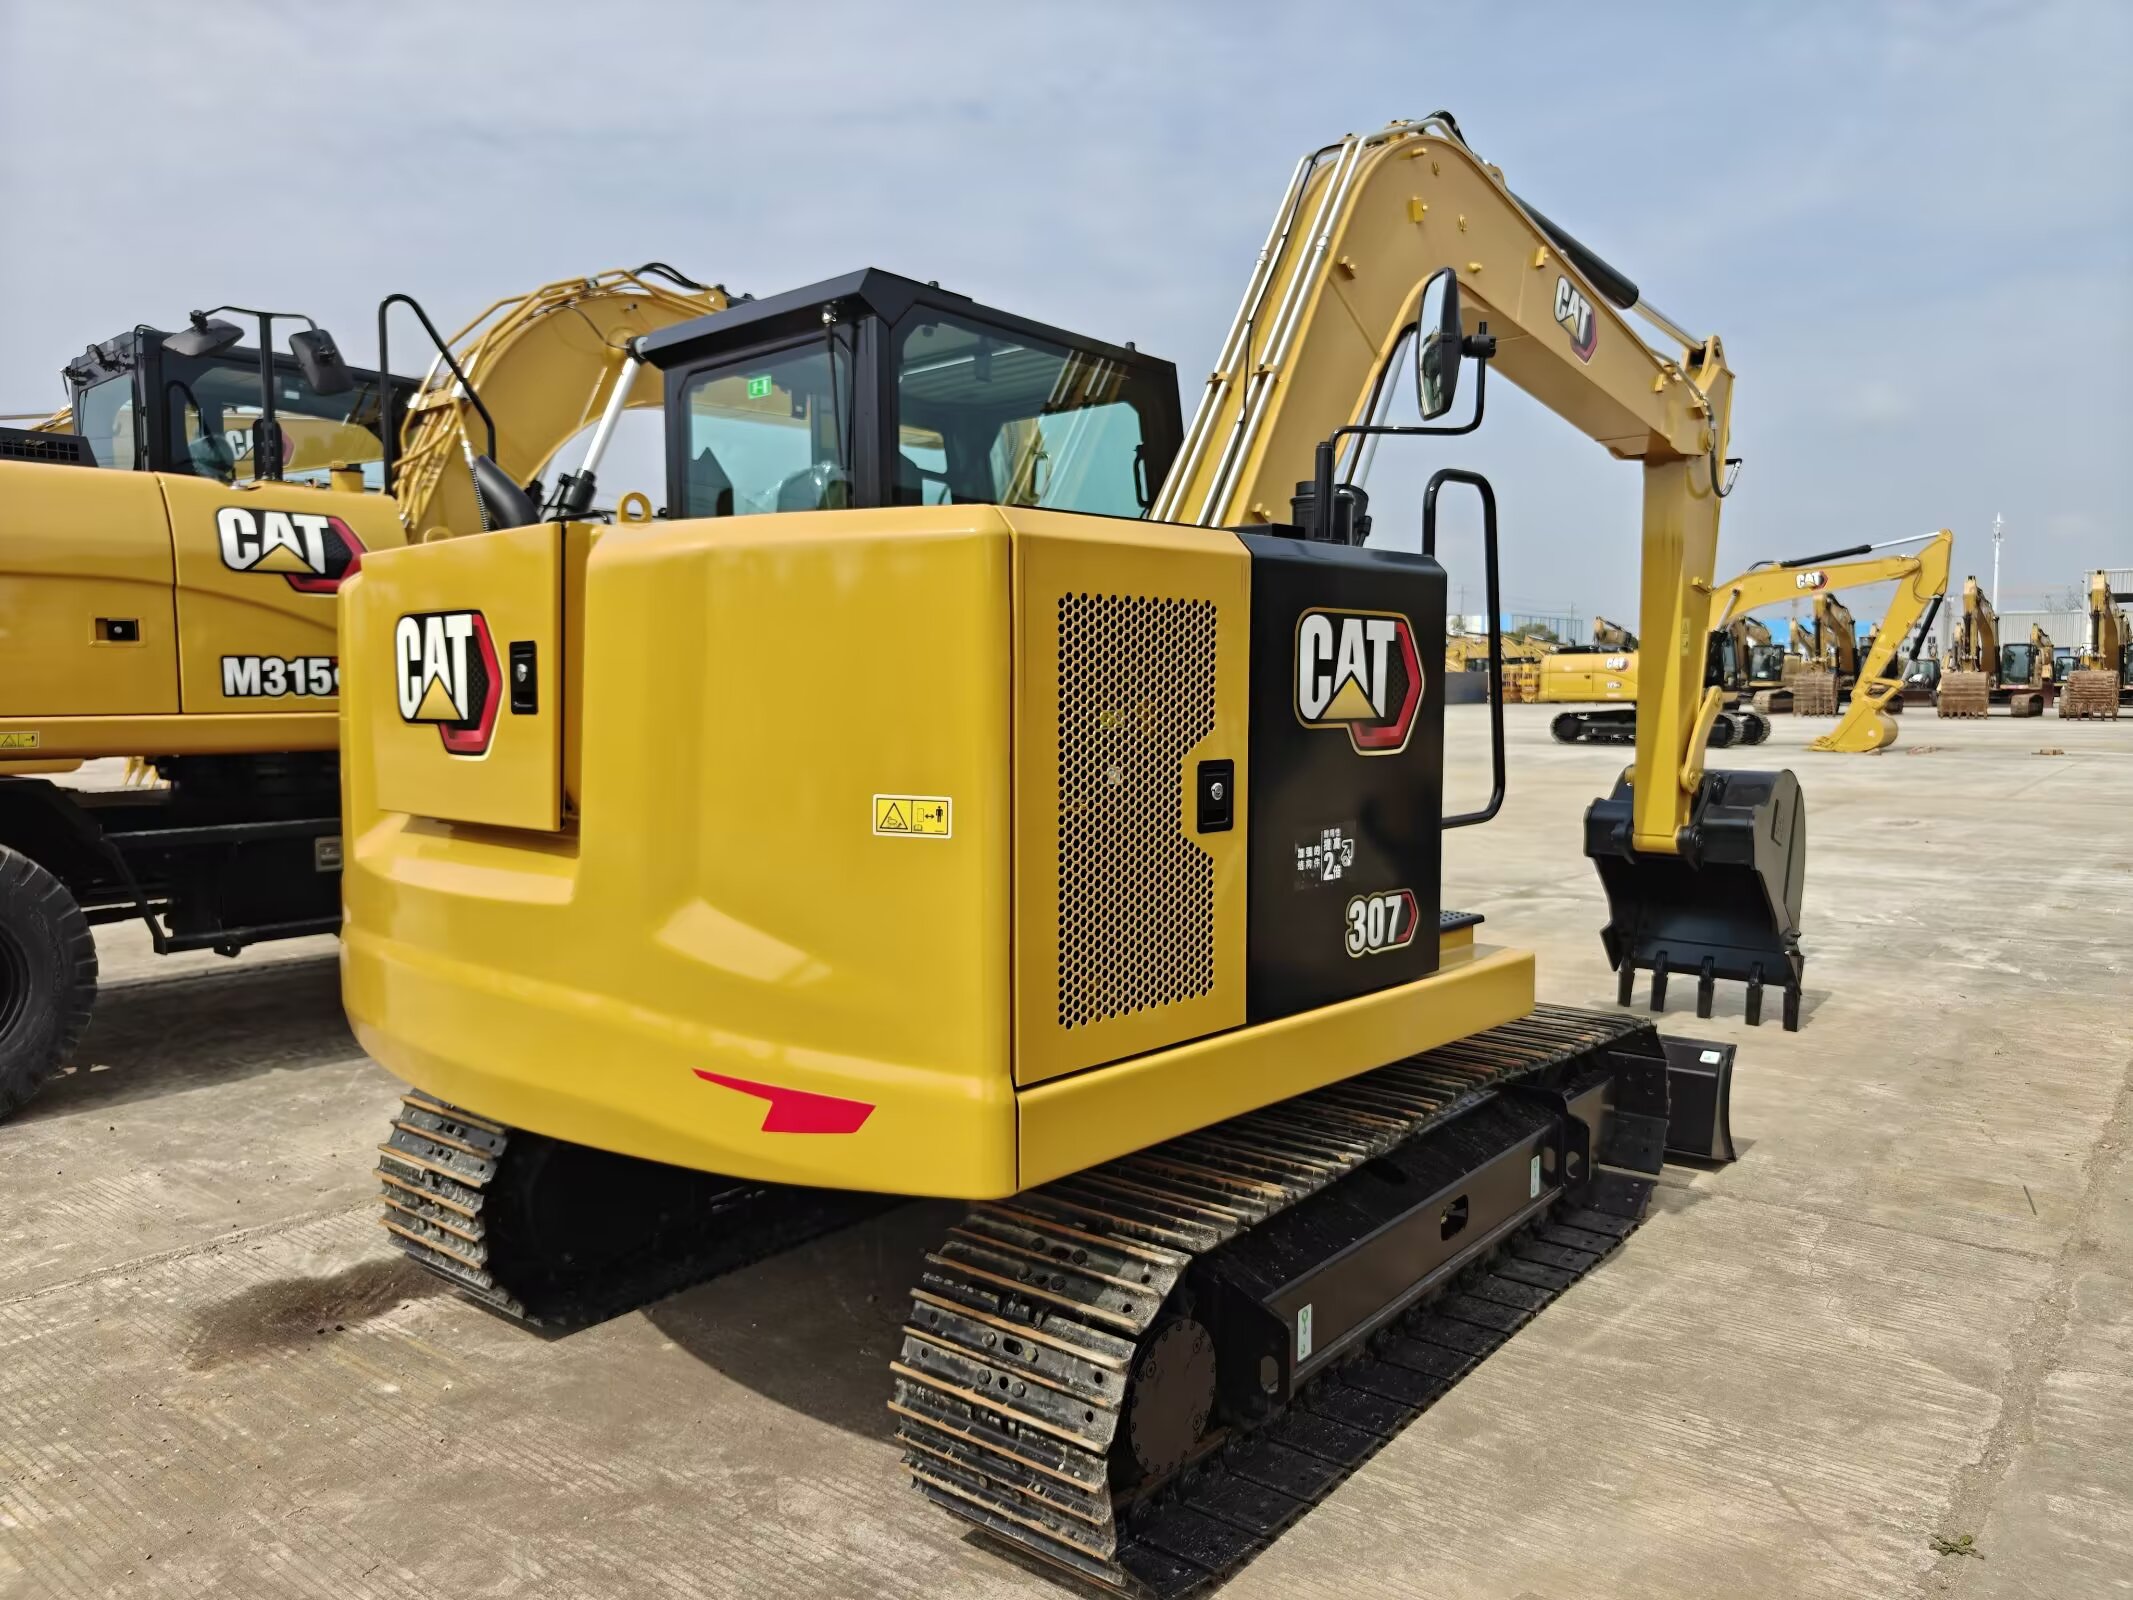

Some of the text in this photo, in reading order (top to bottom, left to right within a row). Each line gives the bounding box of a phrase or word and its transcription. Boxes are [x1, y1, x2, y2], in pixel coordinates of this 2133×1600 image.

[1555, 277, 1592, 344] CAT
[218, 508, 329, 574] CAT
[1796, 571, 1820, 589] CAT
[396, 614, 473, 720] CAT
[1299, 614, 1396, 720] CAT
[1348, 895, 1402, 951] 307
